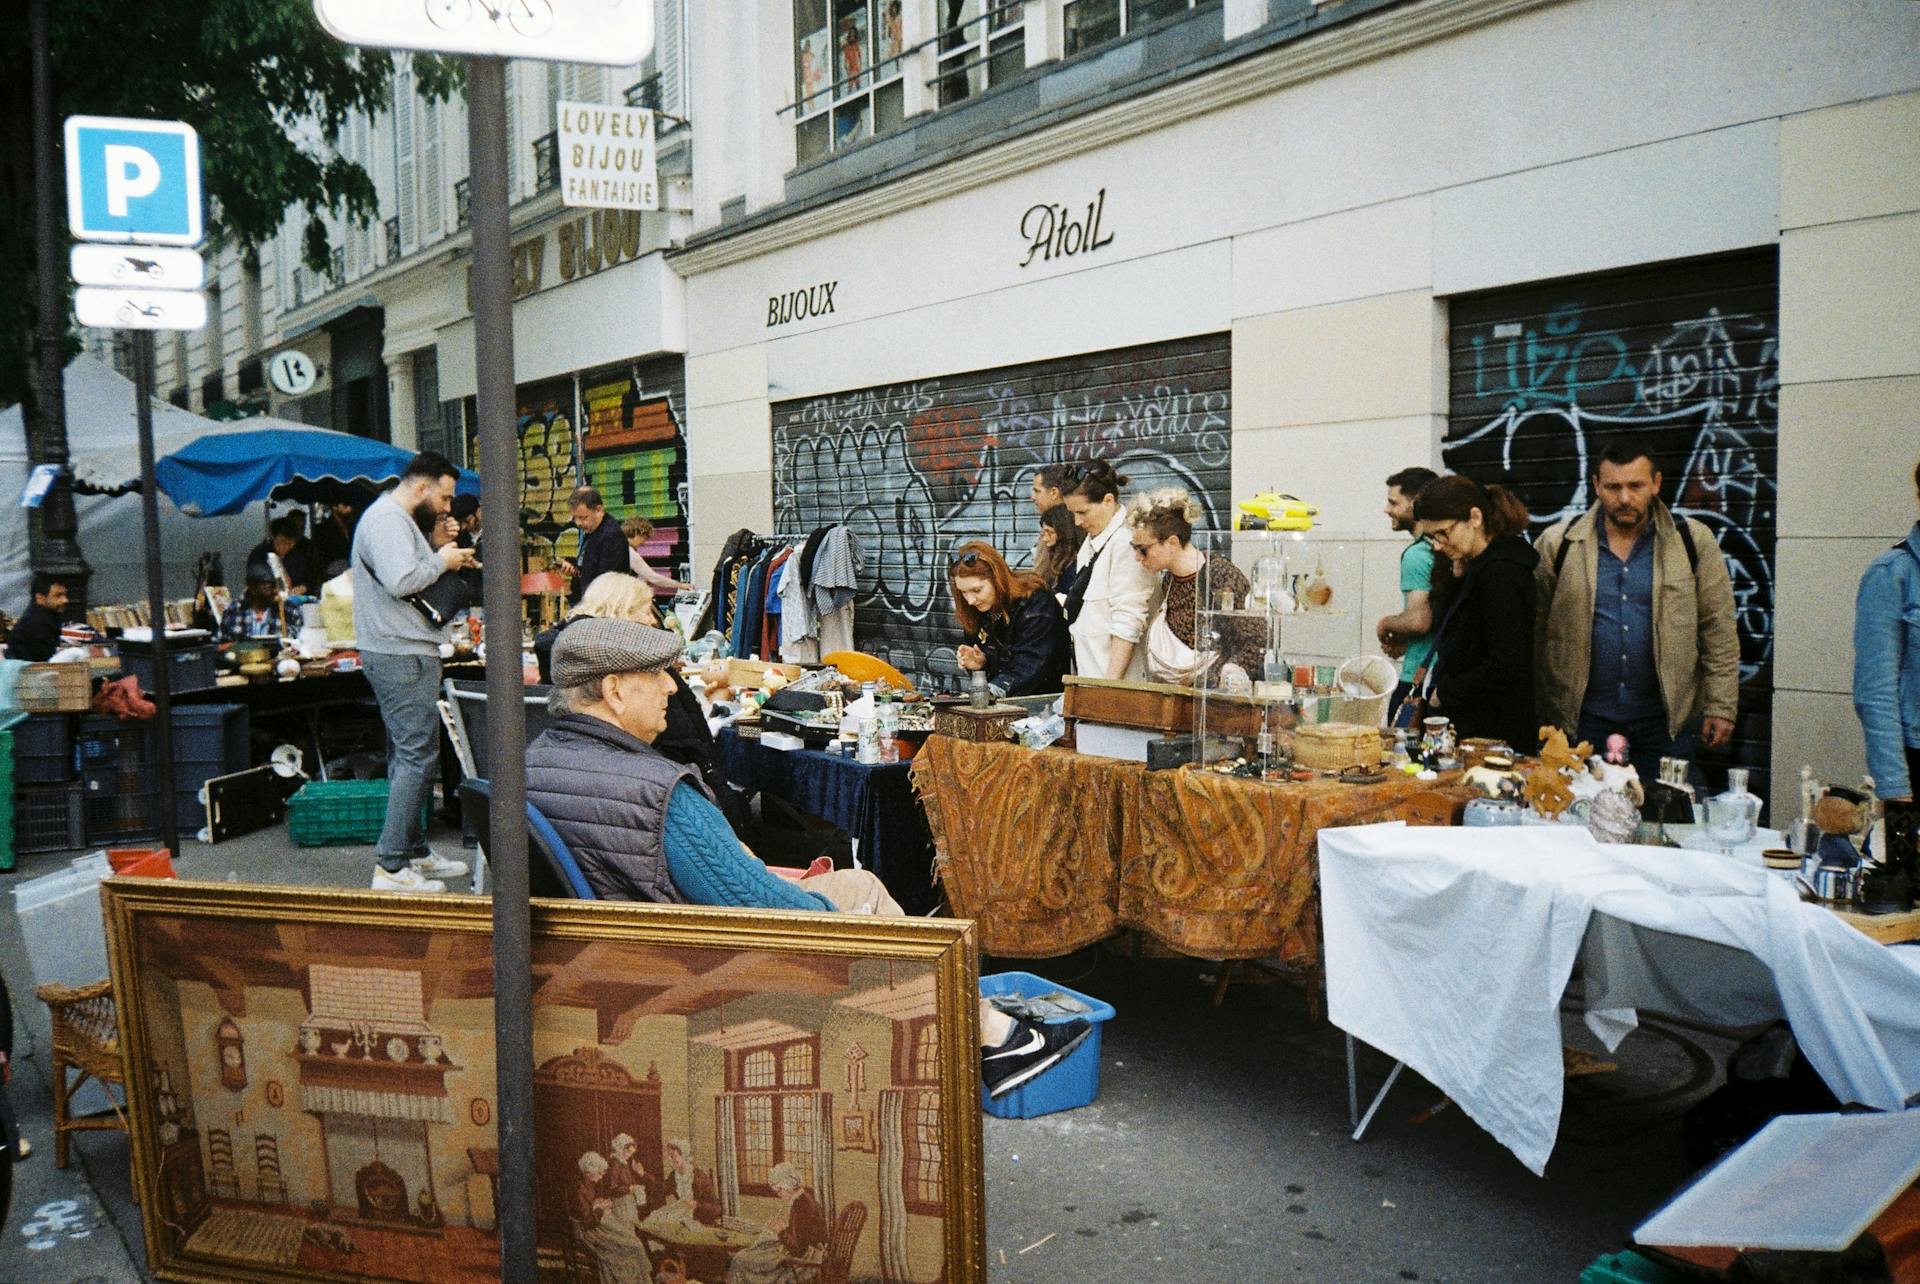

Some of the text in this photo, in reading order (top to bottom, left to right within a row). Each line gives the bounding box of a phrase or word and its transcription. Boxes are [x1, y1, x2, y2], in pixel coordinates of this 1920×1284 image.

[563, 109, 649, 138] LOVELY
[573, 143, 643, 172] BIJOU
[104, 144, 162, 217] P
[569, 177, 652, 204] FANTAISIE
[558, 207, 642, 280] BIJOU
[766, 280, 838, 328] BIJOUX
